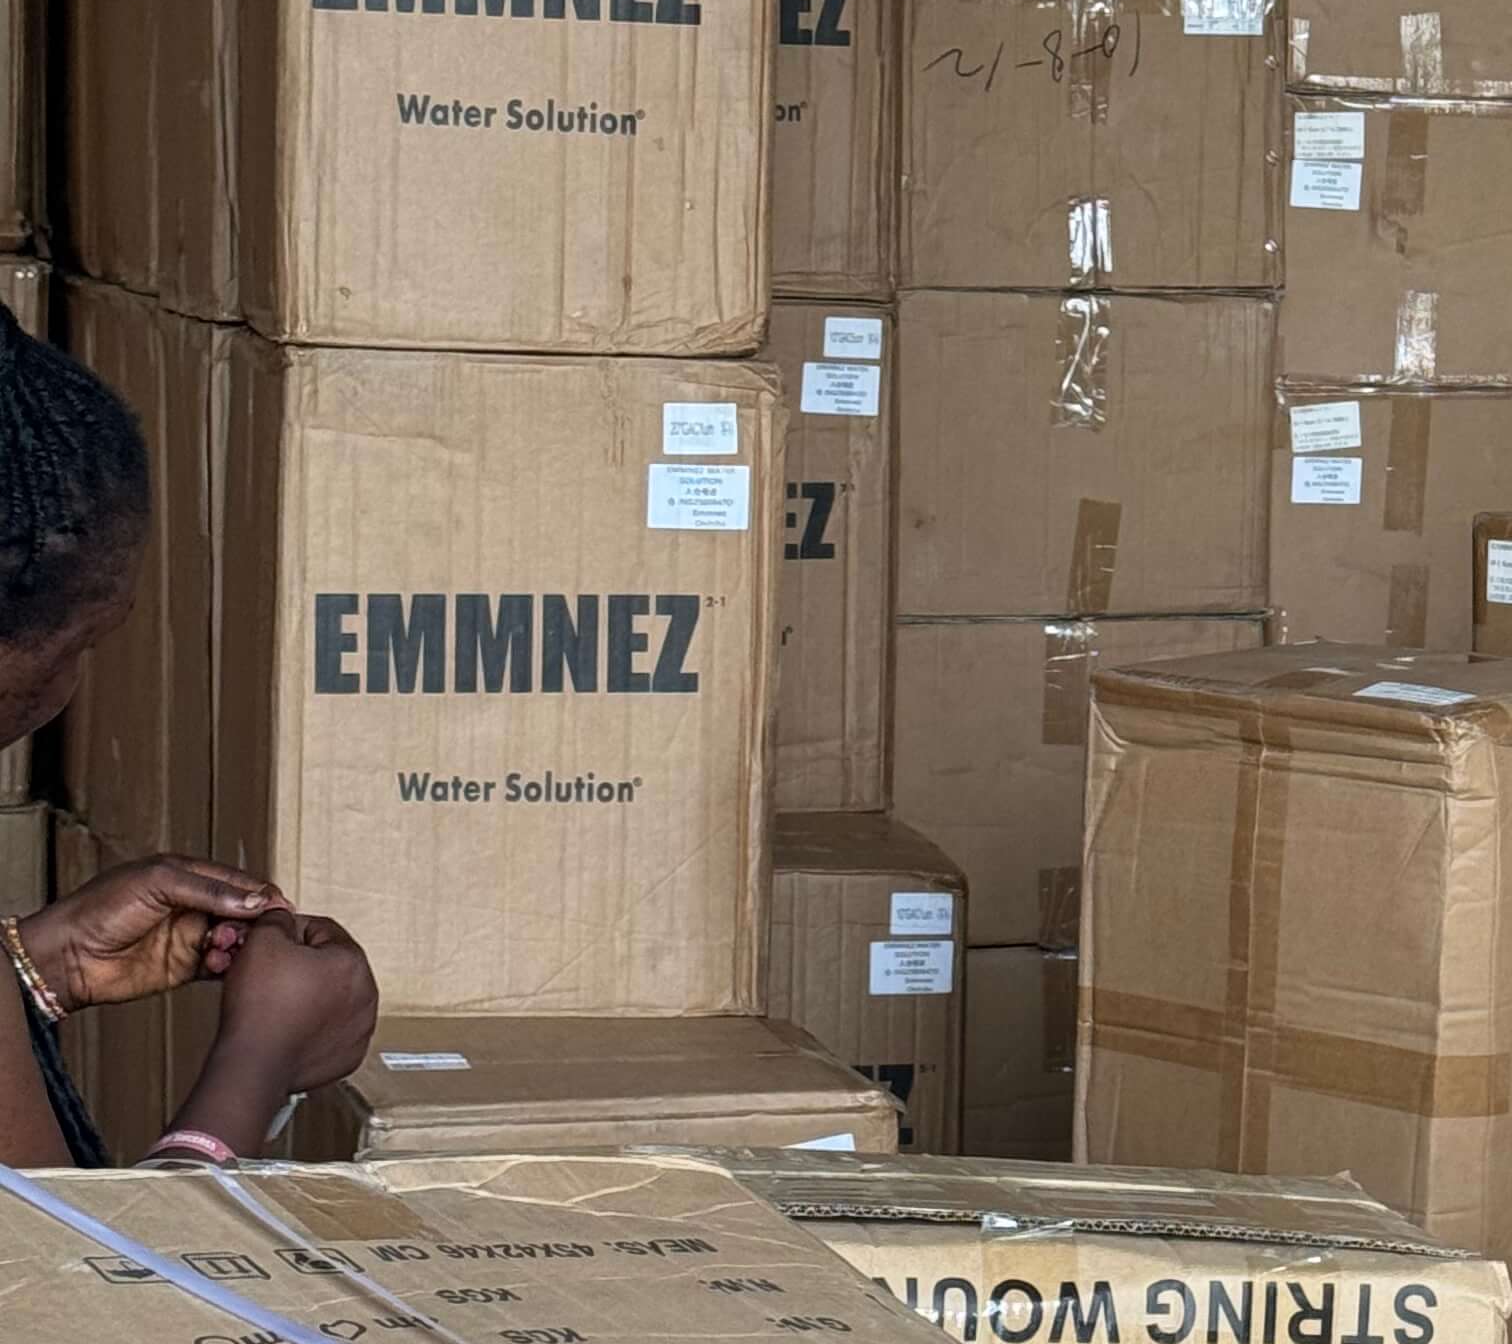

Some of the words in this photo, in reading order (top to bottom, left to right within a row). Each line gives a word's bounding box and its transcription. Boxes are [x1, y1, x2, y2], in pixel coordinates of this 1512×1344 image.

[396, 92, 498, 129] Water
[314, 593, 701, 695] EMMNEZ
[705, 595, 727, 608] 2-1
[397, 772, 497, 803] Water
[368, 1244, 430, 1262] CM
[602, 1237, 718, 1257] MEAS:
[434, 1287, 523, 1304] KGS
[499, 1326, 587, 1344] KGS
